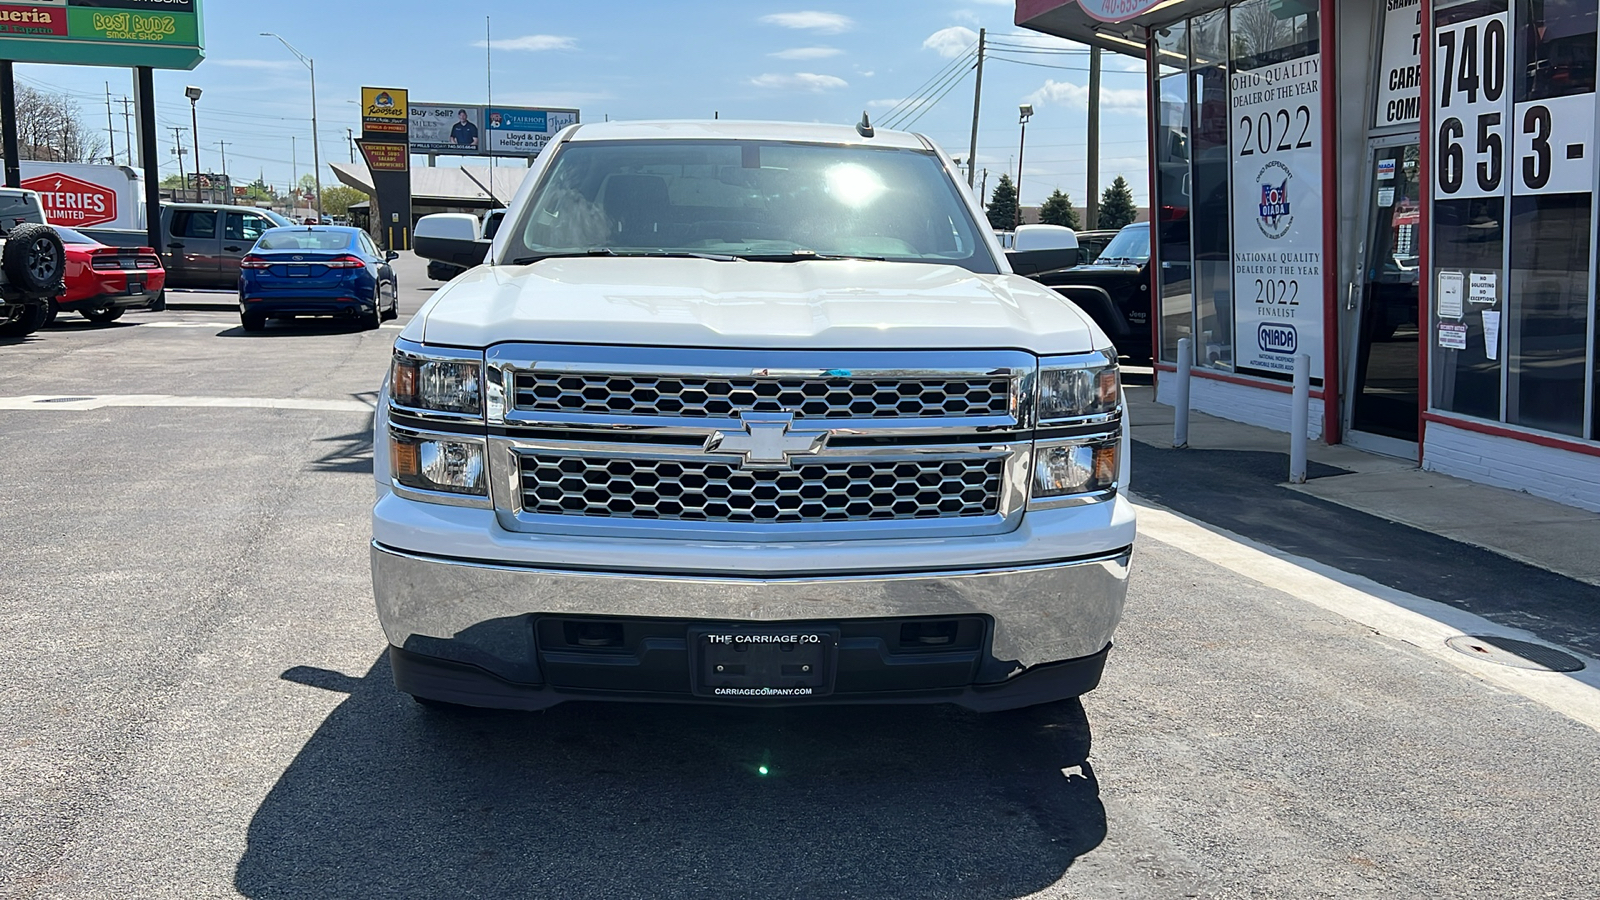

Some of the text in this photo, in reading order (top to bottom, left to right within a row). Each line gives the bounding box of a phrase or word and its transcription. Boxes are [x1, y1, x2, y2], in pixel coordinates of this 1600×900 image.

[12, 25, 53, 34] Tapatio
[132, 15, 175, 34] BUDZ
[106, 31, 163, 41] SMOKE SHOP
[1438, 19, 1505, 108] 740
[1232, 59, 1320, 91] OHIO QUALITY
[1233, 80, 1318, 108] DEALER OF THE YEAR
[368, 104, 403, 116] Roosters
[411, 109, 426, 117] Buy
[549, 115, 574, 127] Thank
[506, 132, 526, 141] Lloyd
[1240, 105, 1312, 157] 2022
[499, 139, 524, 147] Helber
[1262, 204, 1285, 216] OIADA
[1235, 253, 1320, 264] NATIONAL QUALITY
[1236, 265, 1319, 275] DEALER OF THE YEAR
[1255, 278, 1299, 306] 2022
[1257, 307, 1295, 318] FINALIST
[708, 634, 821, 643] THE CARRIAGE CO.
[714, 688, 812, 696] CARRIAGECOMPANY.COM
